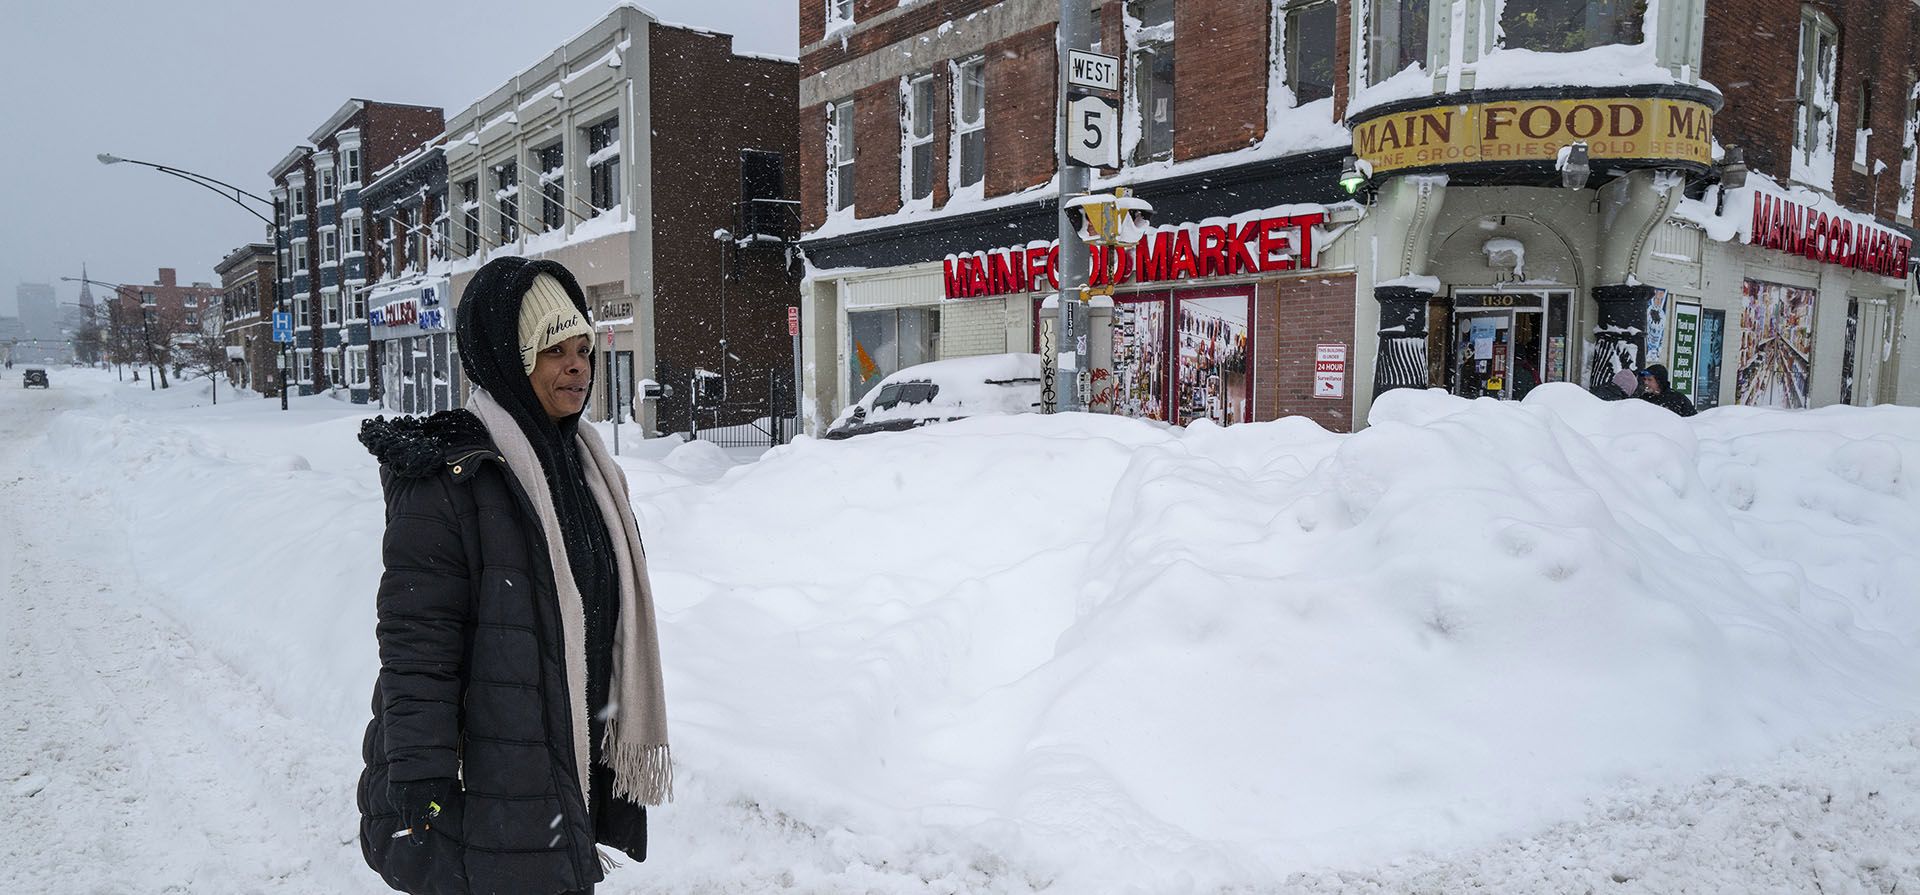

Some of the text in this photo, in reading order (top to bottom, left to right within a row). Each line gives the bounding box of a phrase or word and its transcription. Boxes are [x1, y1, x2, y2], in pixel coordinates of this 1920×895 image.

[1073, 58, 1111, 83] WEST
[1083, 111, 1102, 149] 5
[1360, 111, 1454, 156] MAIN
[1483, 104, 1643, 140] FOOD
[1417, 142, 1556, 161] GROCERIES
[1592, 141, 1635, 154] OLD
[1751, 190, 1912, 279] MAIN FOOD MARKET
[943, 251, 1024, 299] MAIN
[1135, 213, 1326, 283] MARKET
[1482, 295, 1513, 306] 1130
[276, 314, 288, 329] H
[545, 314, 577, 345] phat
[1317, 363, 1343, 371] 24 HOUR
